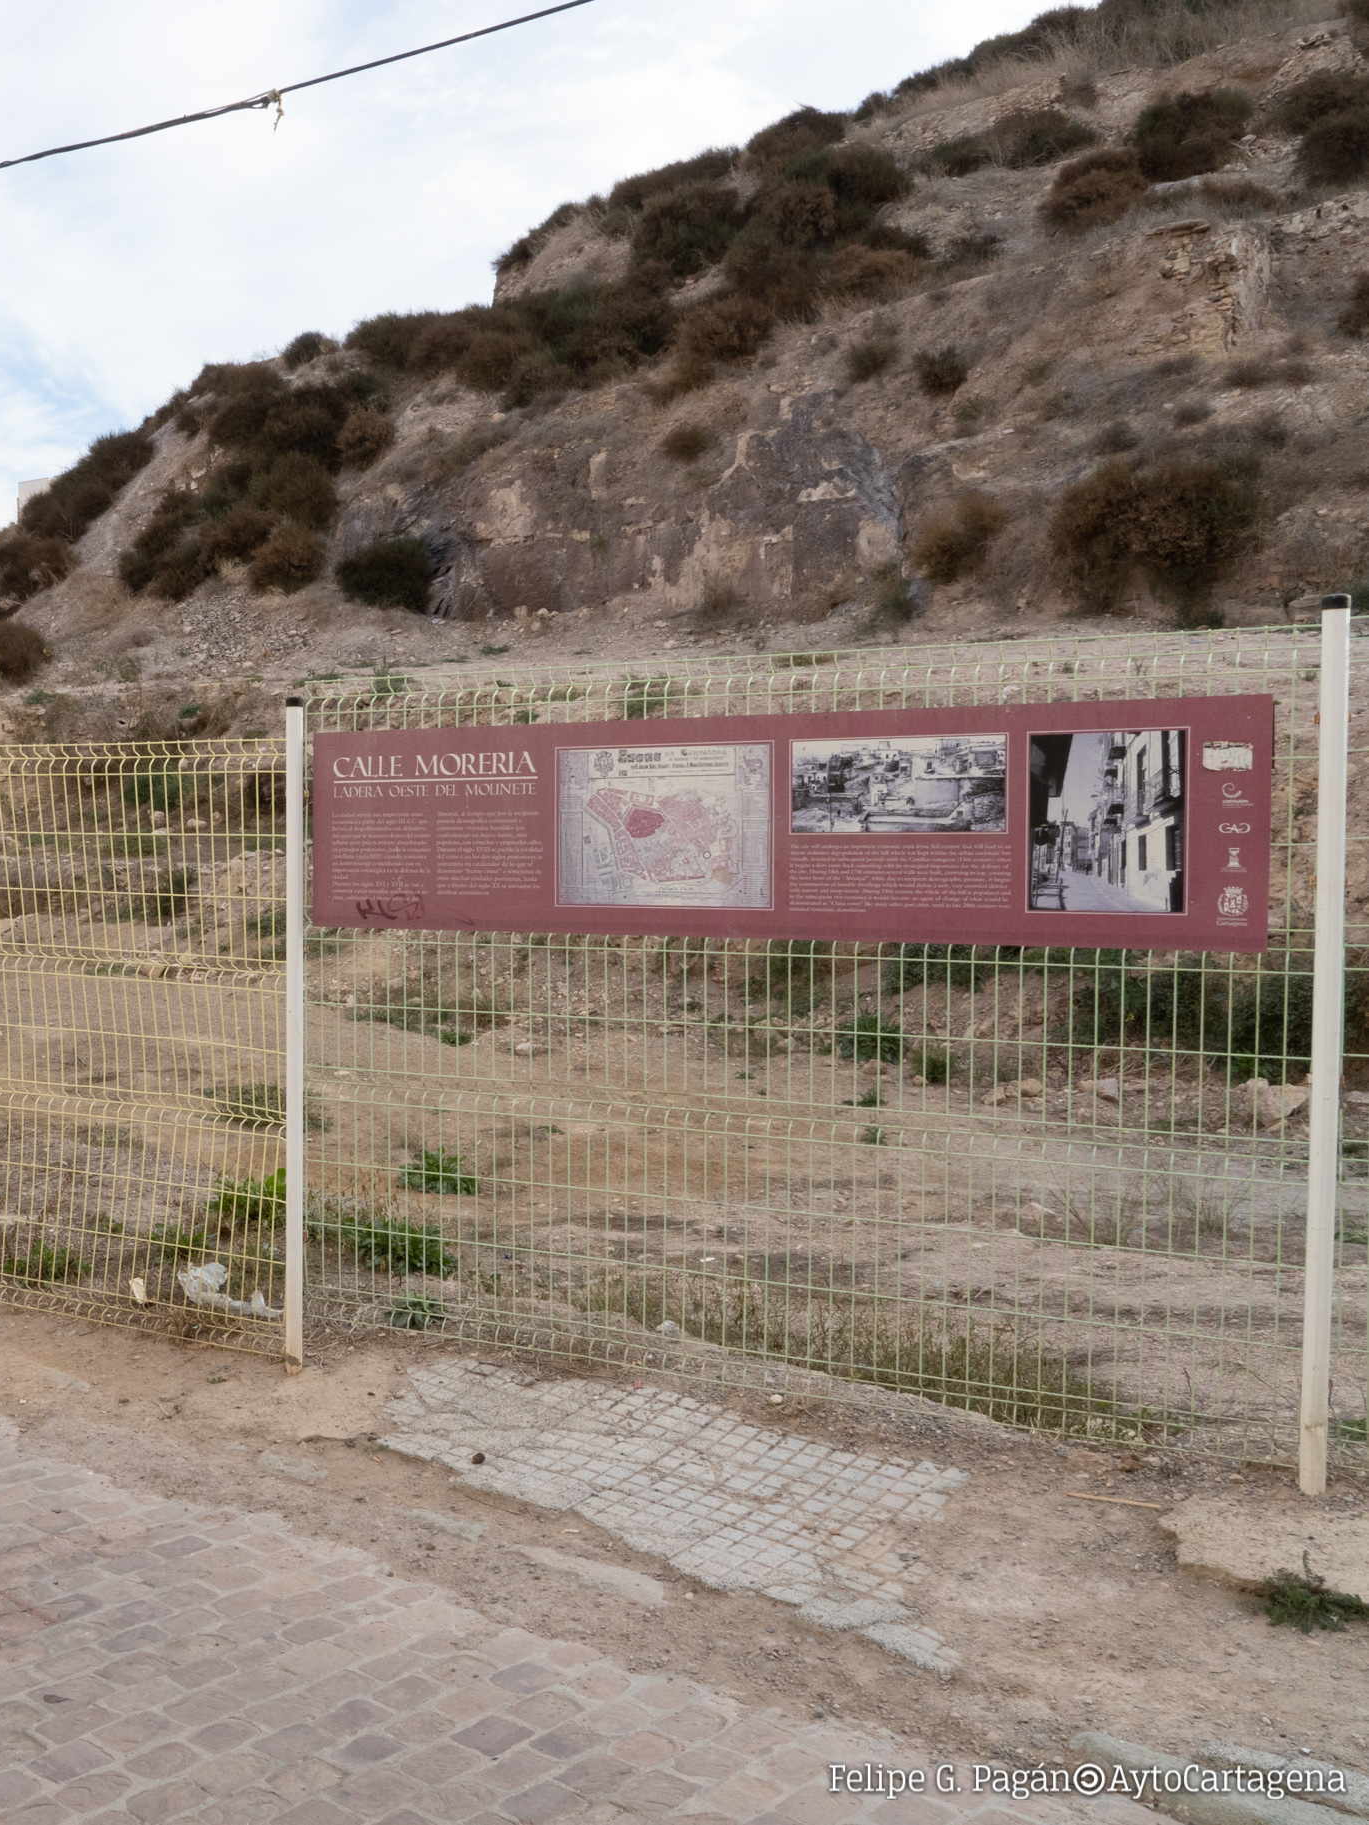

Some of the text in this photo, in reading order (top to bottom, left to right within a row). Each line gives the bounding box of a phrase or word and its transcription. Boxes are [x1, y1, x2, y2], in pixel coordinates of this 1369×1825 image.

[333, 751, 537, 778] CALLE MORERIA
[333, 782, 537, 798] LADERA OESTE DEL MOLINETE
[1216, 920, 1248, 928] Cartagena
